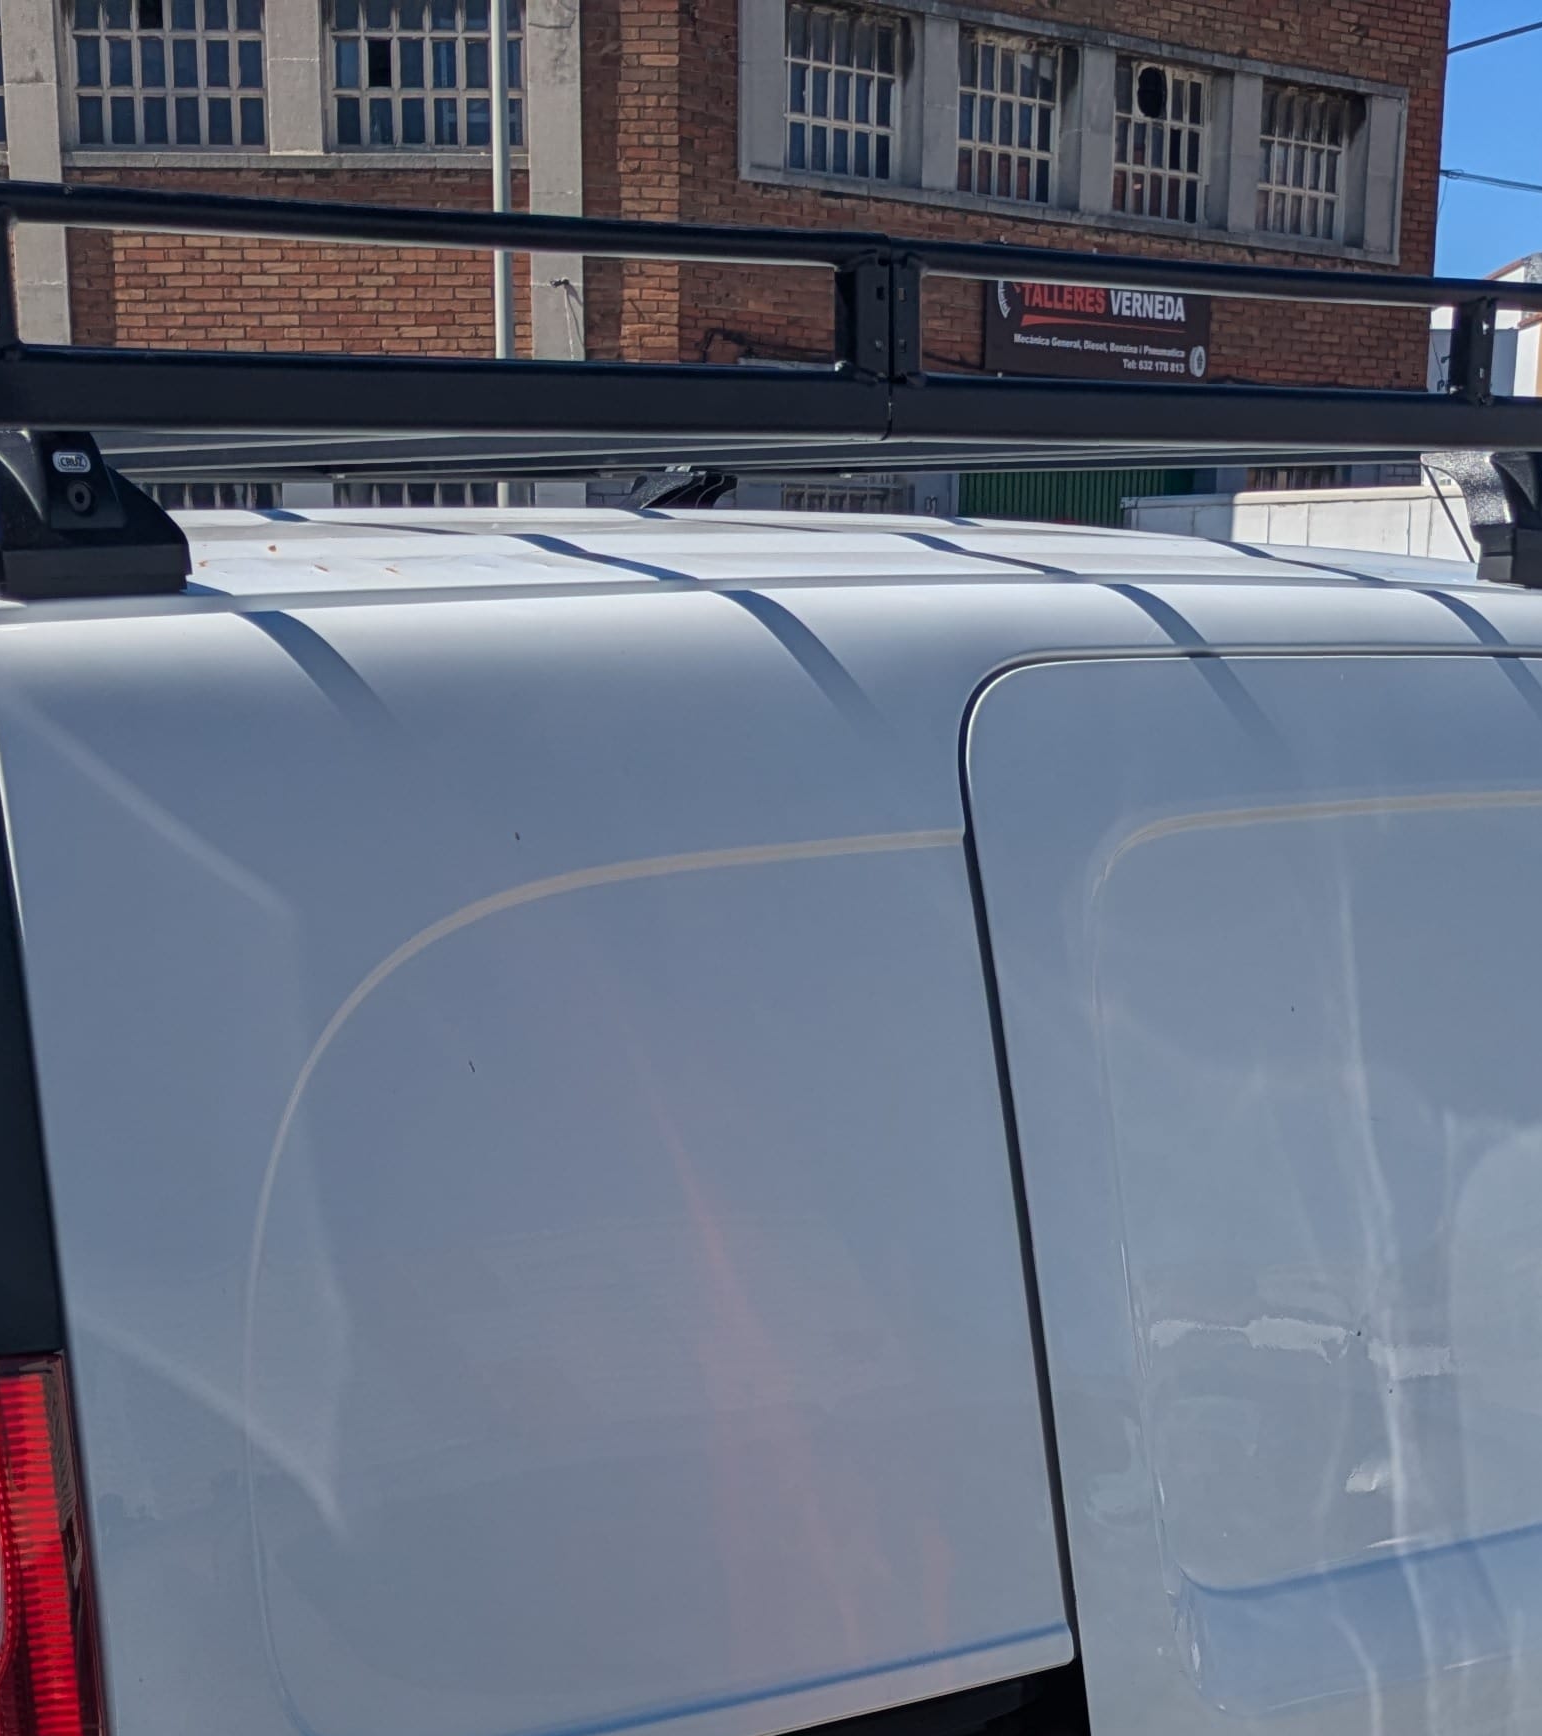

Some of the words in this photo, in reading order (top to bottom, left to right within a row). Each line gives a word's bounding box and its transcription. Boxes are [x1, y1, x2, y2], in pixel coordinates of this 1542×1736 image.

[1022, 282, 1106, 314] TALLERES
[1110, 289, 1186, 322] VERNEDA
[60, 457, 86, 467] CRUZ
